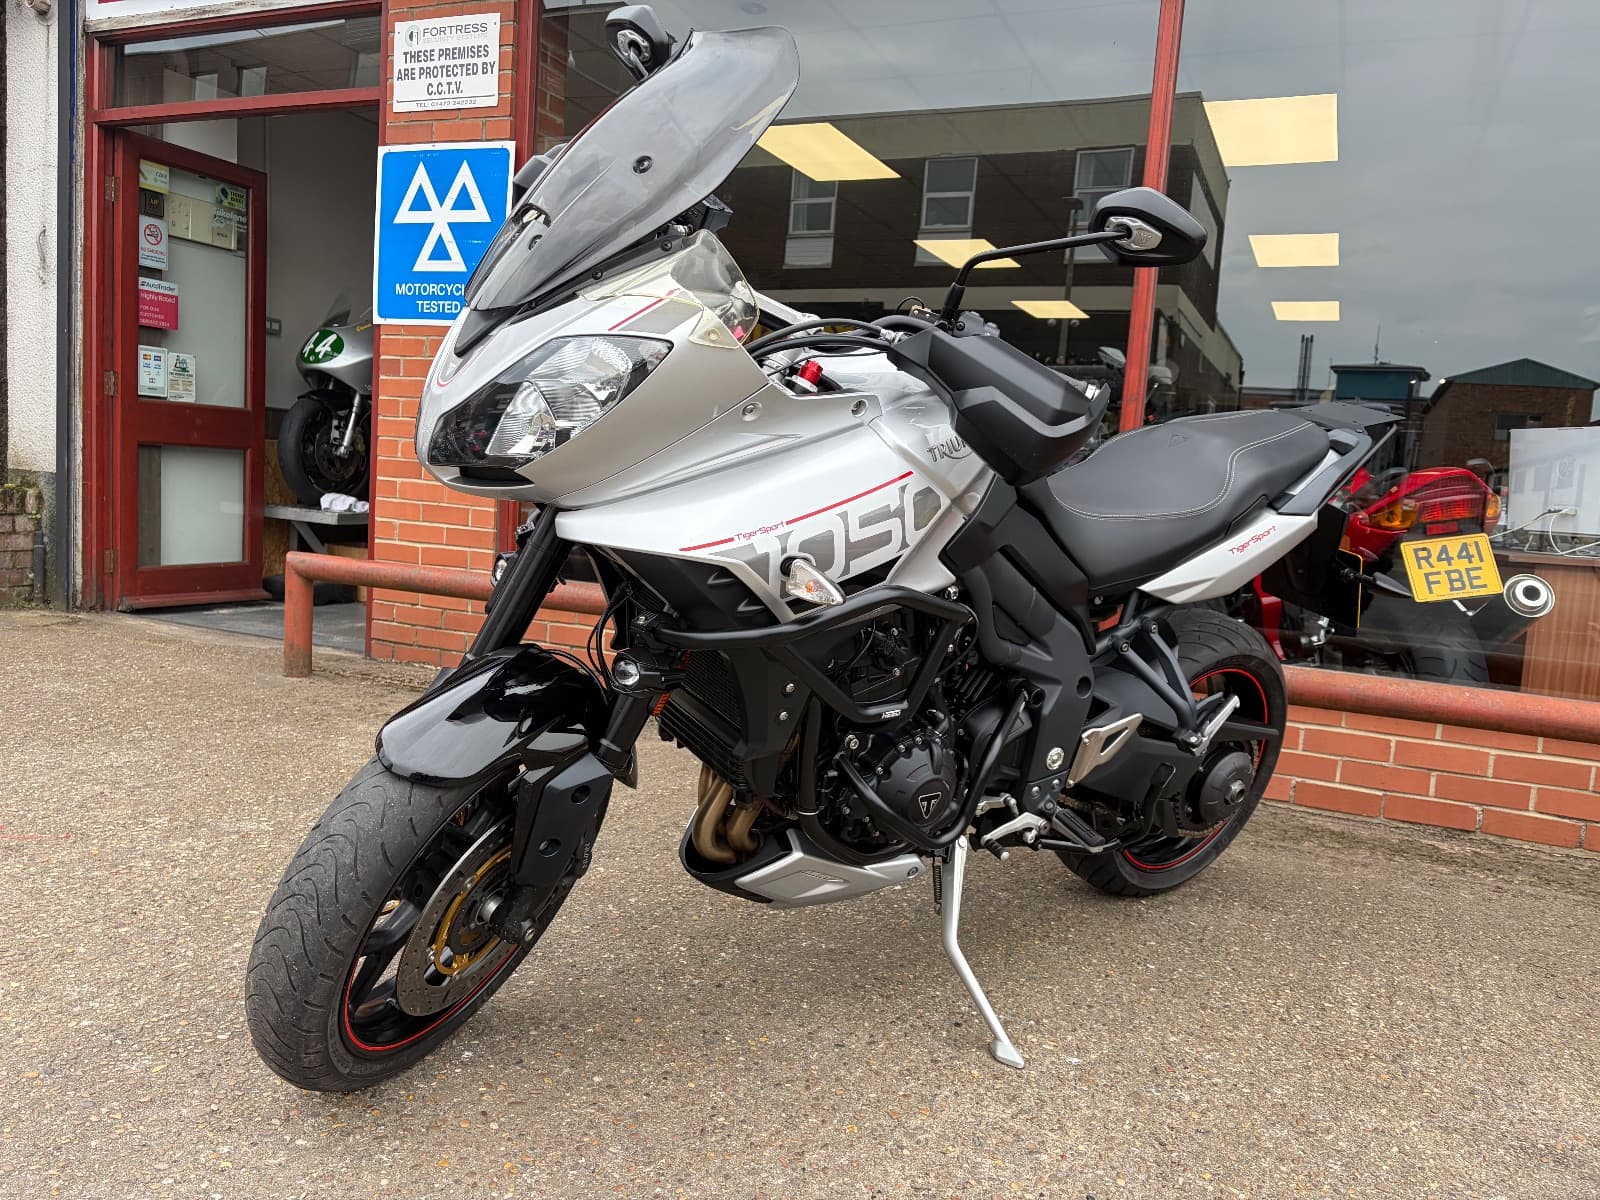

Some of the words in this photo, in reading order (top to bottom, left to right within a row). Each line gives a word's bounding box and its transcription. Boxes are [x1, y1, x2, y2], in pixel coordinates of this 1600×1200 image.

[422, 22, 488, 37] FORTRESS
[403, 49, 435, 64] THESE
[438, 44, 489, 61] PREMISES
[396, 68, 416, 81] ARE
[418, 62, 478, 79] PROTECTED
[481, 61, 496, 75] BY
[426, 81, 463, 96] C.C.T.V.
[395, 283, 465, 295] MOTORCYCL
[416, 301, 460, 313] TESTED
[926, 435, 967, 463] TRIU
[734, 521, 785, 542] TigerSport
[1229, 524, 1277, 554] TigerSport
[1413, 541, 1483, 570] R441
[1424, 567, 1488, 595] FBE
